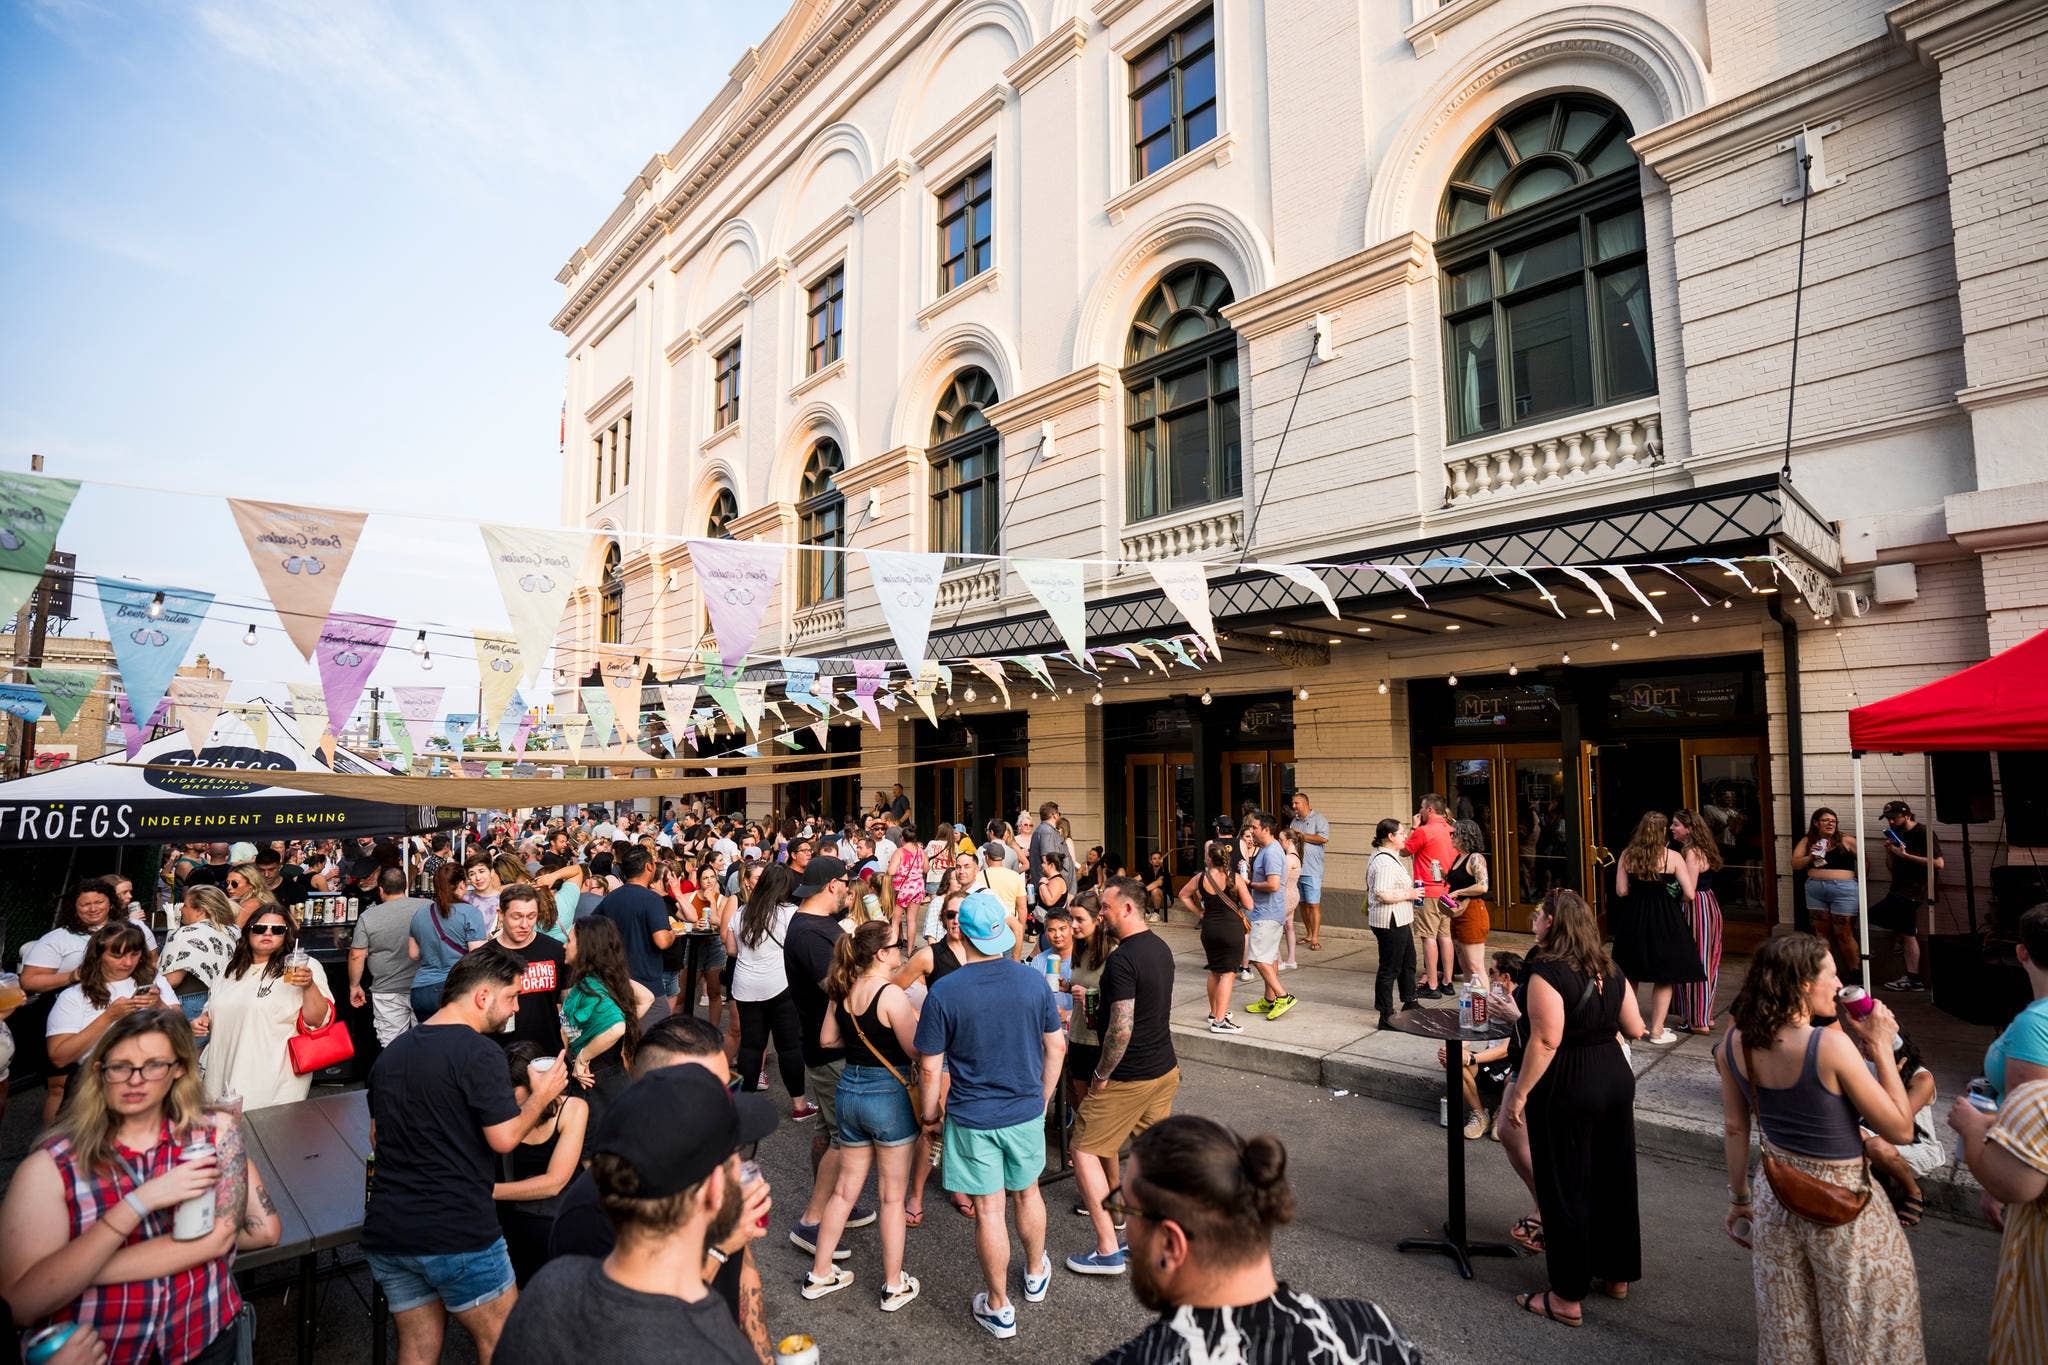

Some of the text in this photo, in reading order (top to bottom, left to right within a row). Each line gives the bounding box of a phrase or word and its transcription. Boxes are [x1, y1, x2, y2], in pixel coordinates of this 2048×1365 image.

[117, 605, 146, 619] Beer
[483, 640, 520, 655] Beer Gar
[1633, 687, 1681, 706] MET
[1464, 698, 1502, 715] MET
[33, 749, 71, 769] er
[140, 814, 263, 827] INDEPENDENT
[275, 812, 347, 825] BREWING
[524, 964, 554, 978] HING
